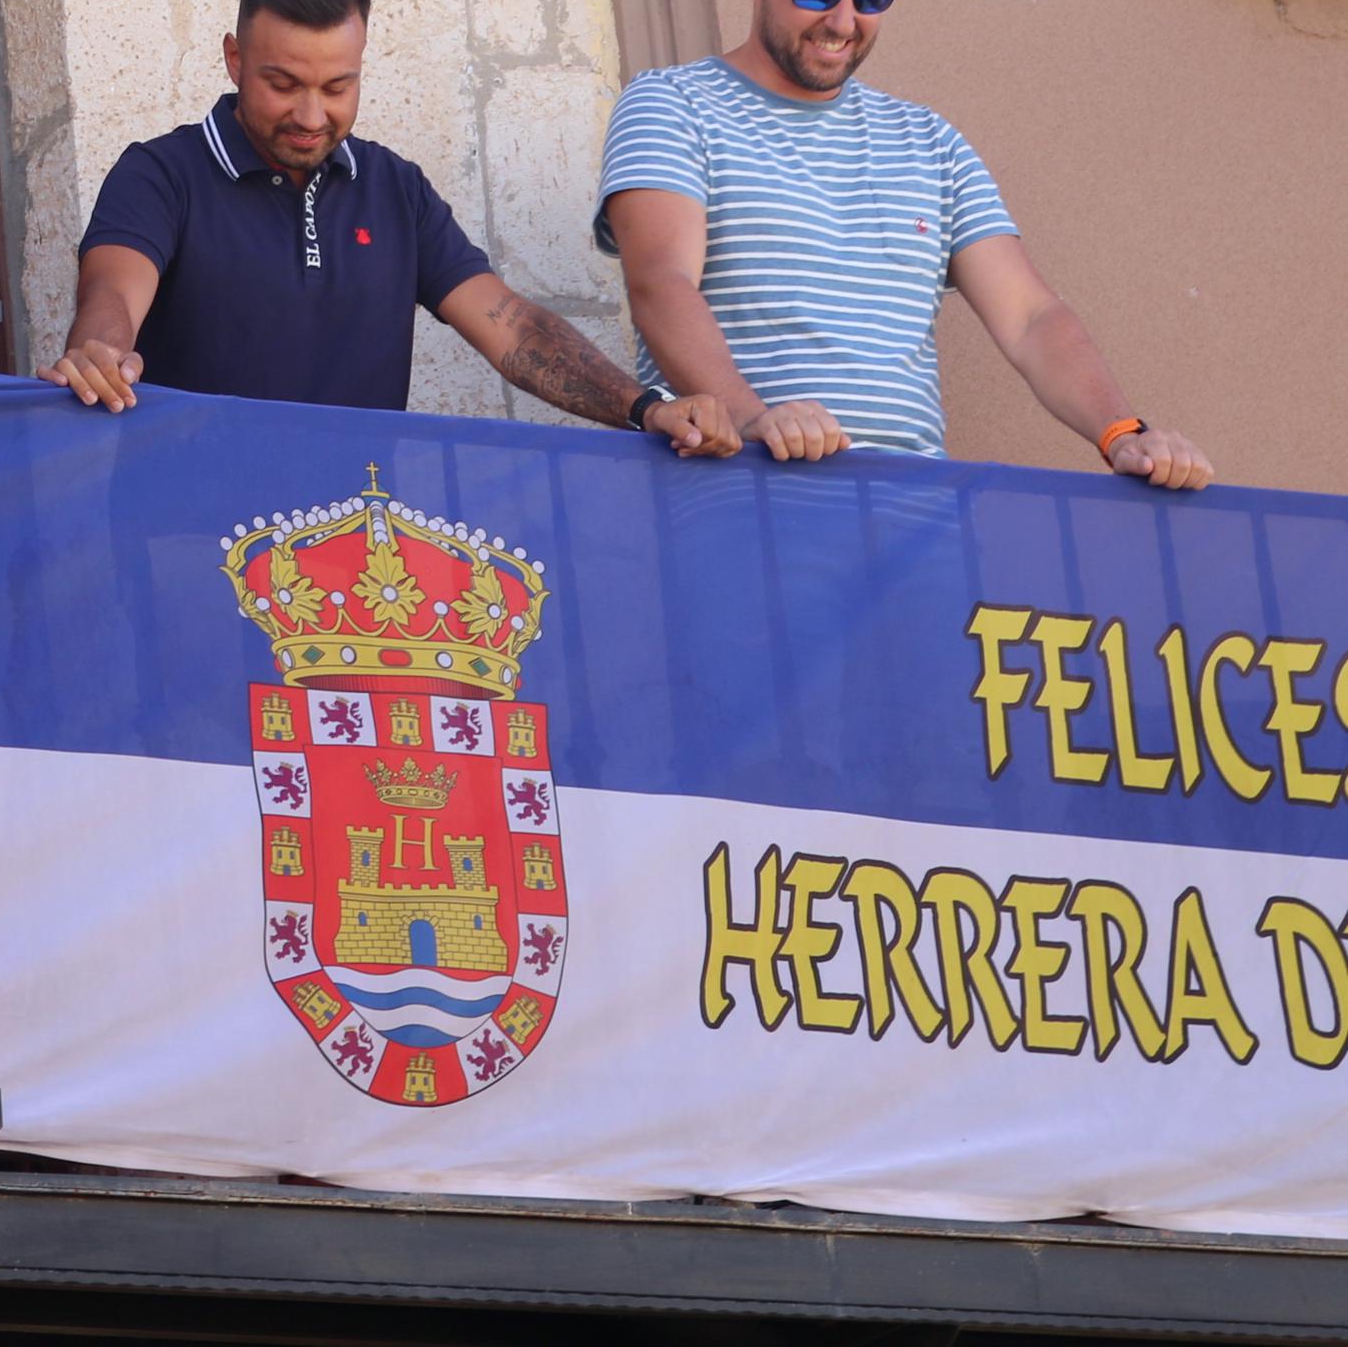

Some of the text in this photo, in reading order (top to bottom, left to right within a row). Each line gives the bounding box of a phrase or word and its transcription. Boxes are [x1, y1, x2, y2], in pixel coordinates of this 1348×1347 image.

[305, 242, 322, 269] EL
[965, 601, 1348, 808] FELICE
[388, 813, 437, 873] H
[699, 840, 1348, 1070] HERRERA D
